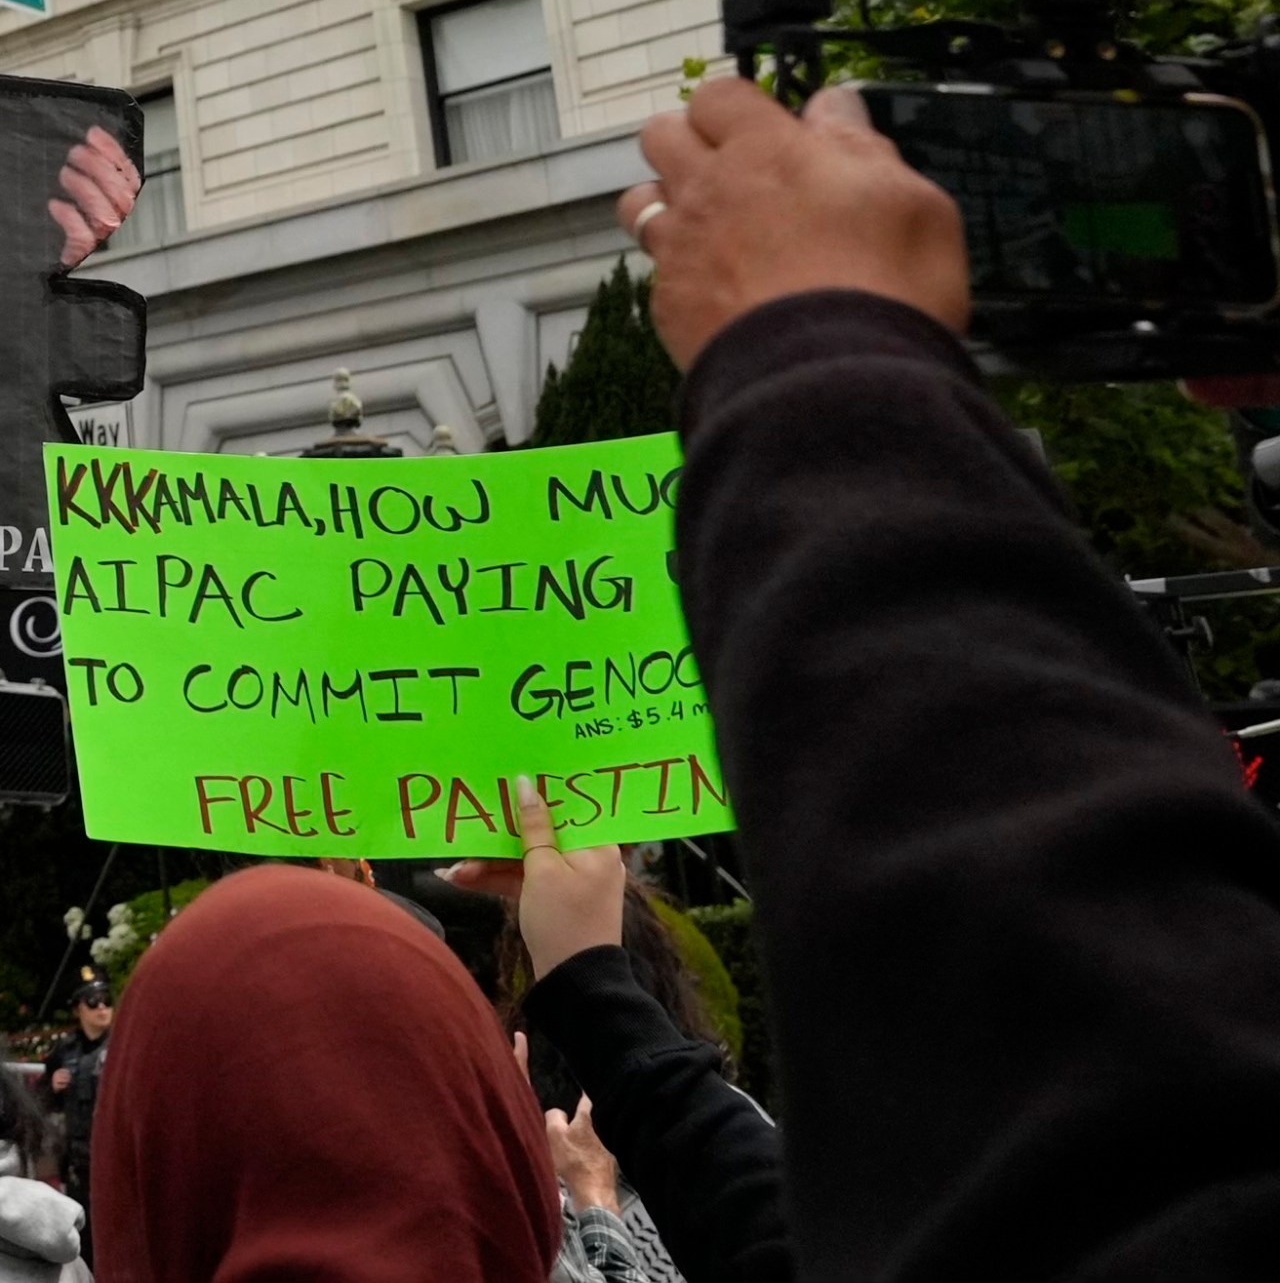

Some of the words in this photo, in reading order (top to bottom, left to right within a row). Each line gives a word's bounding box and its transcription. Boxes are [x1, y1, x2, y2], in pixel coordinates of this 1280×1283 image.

[78, 419, 121, 447] Way
[547, 466, 684, 522] MUC
[63, 554, 304, 629] AIPAC
[349, 555, 634, 626] PAYING
[67, 657, 145, 708] TO
[183, 663, 481, 725] COMMIT
[510, 644, 704, 722] GENOC
[574, 717, 623, 740] ANS:
[194, 772, 357, 838] FREE
[397, 753, 728, 845] PALESTIN
